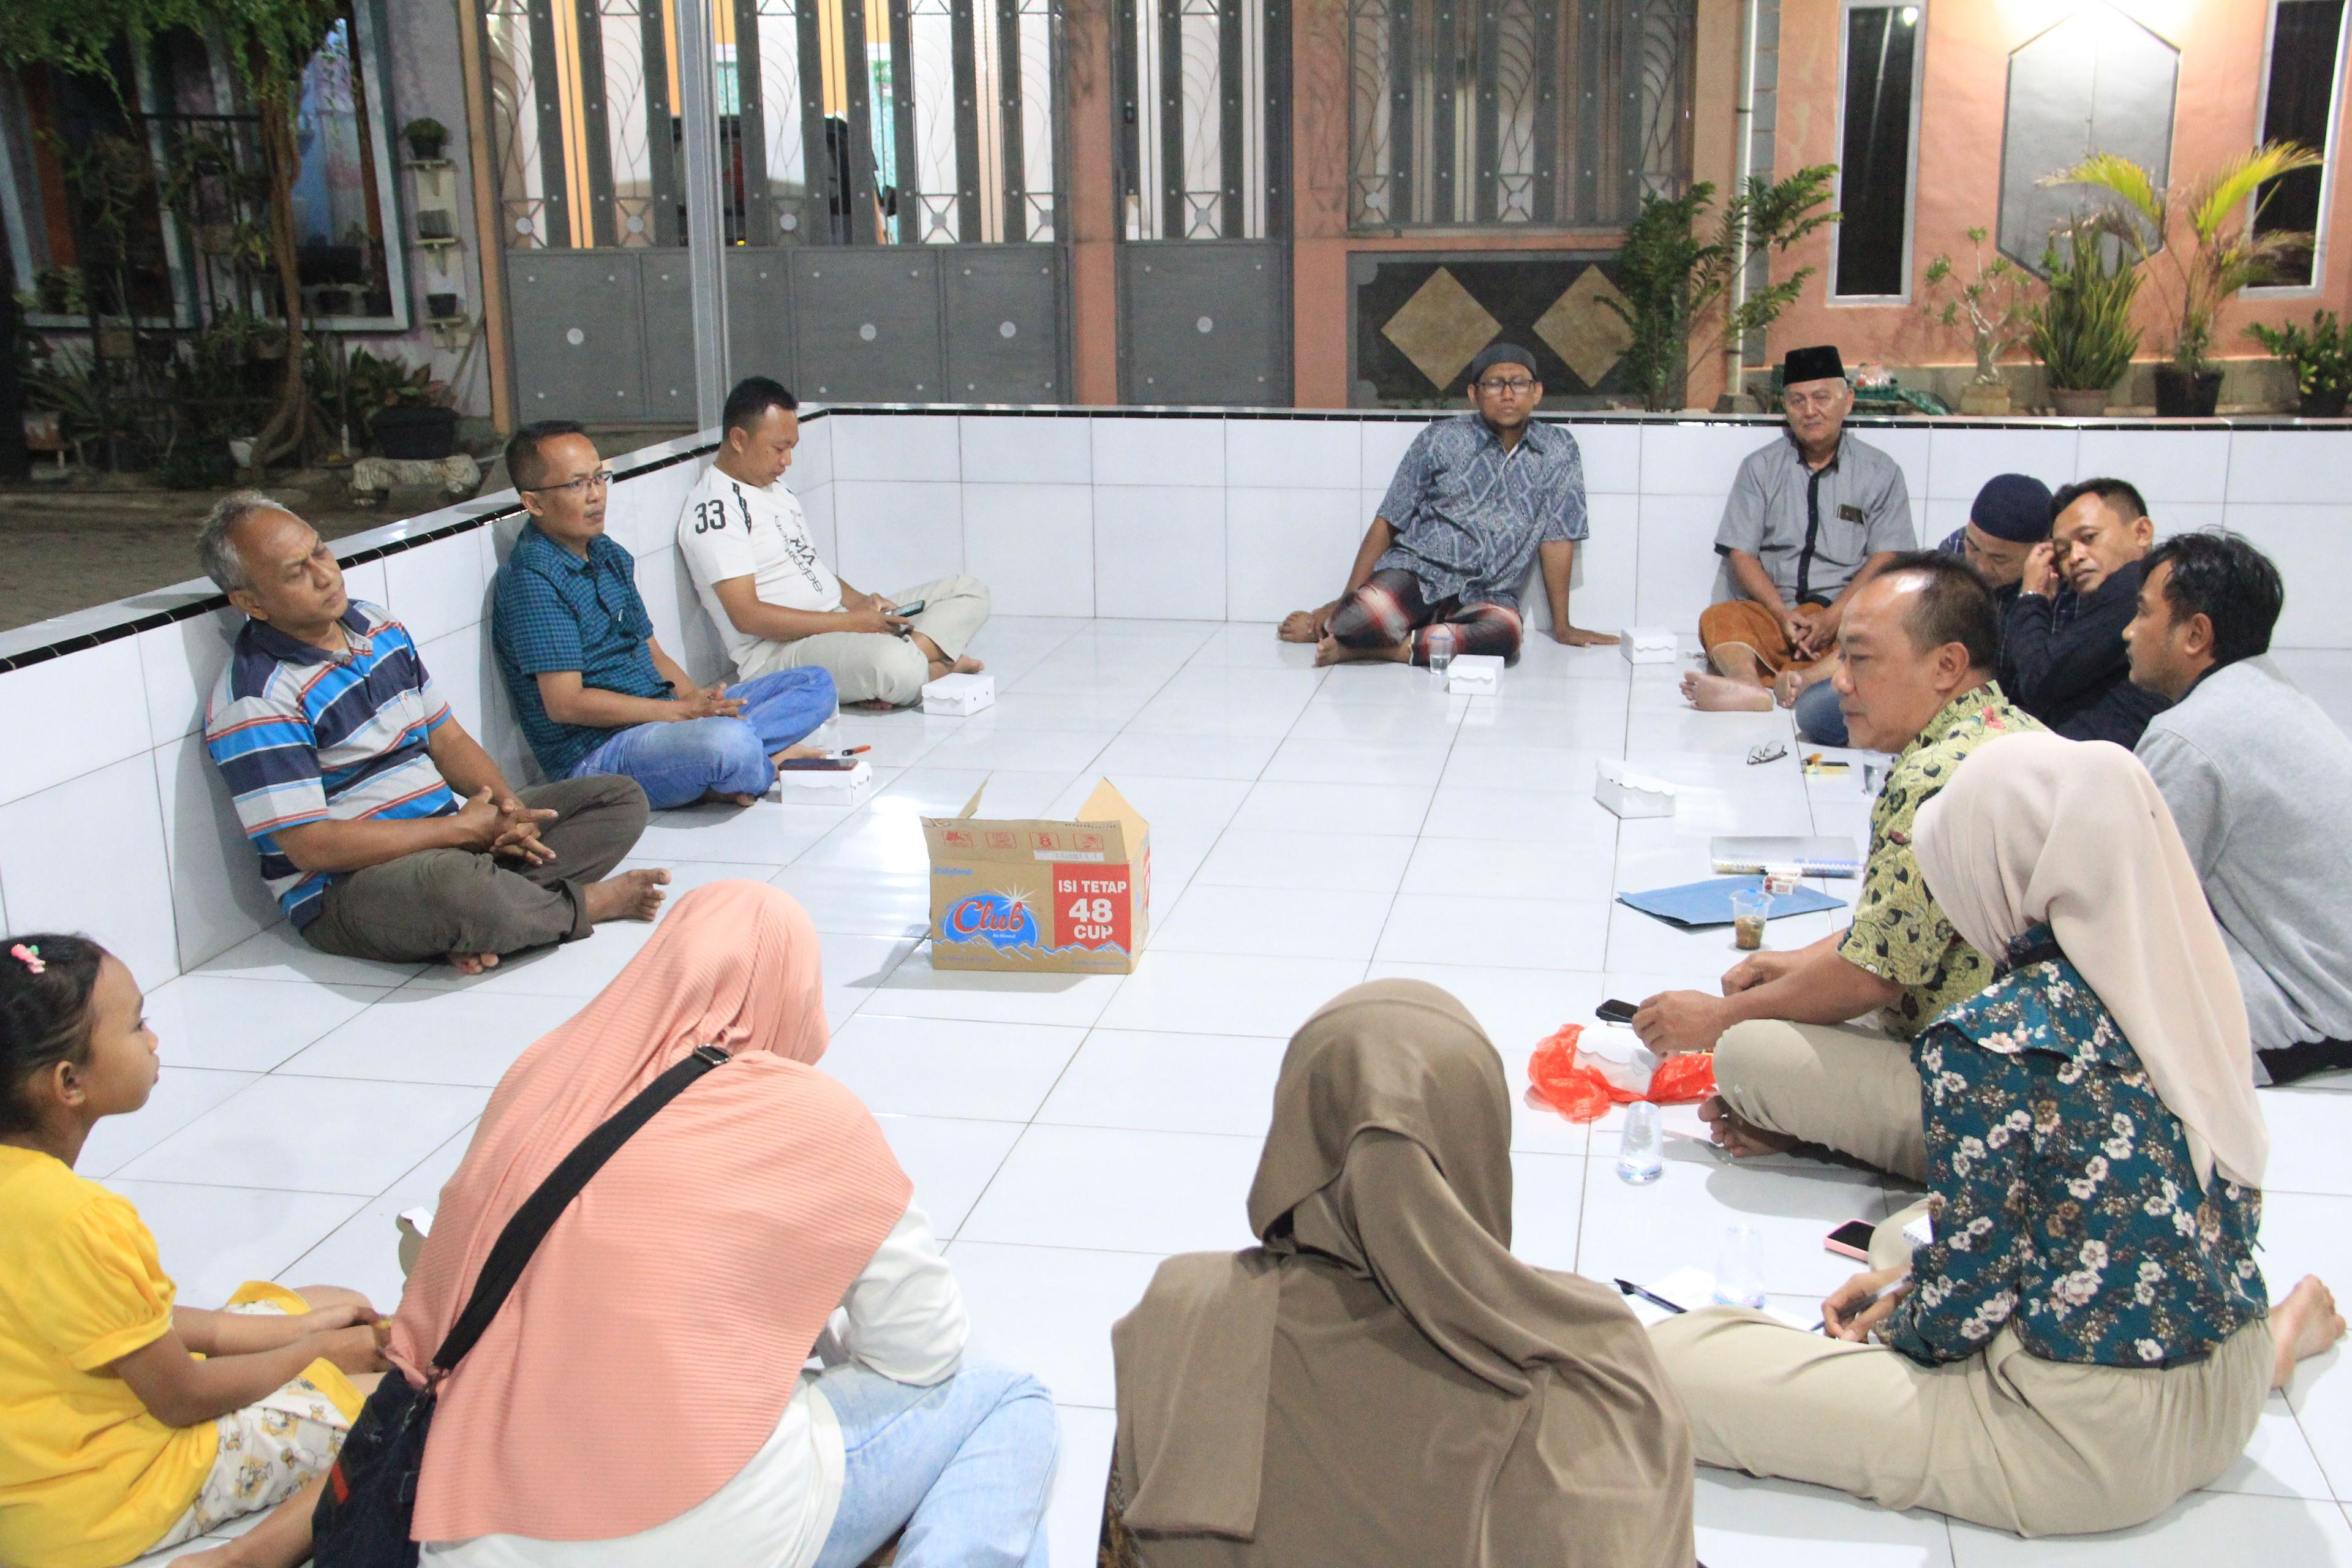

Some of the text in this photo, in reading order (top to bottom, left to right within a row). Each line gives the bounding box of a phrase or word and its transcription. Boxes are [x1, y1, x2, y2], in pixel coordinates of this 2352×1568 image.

[695, 499, 726, 535] 33
[1058, 880, 1127, 894] ISI TETAP
[953, 900, 1025, 933] Club
[1069, 898, 1113, 924] 48
[1074, 924, 1114, 939] CUP
